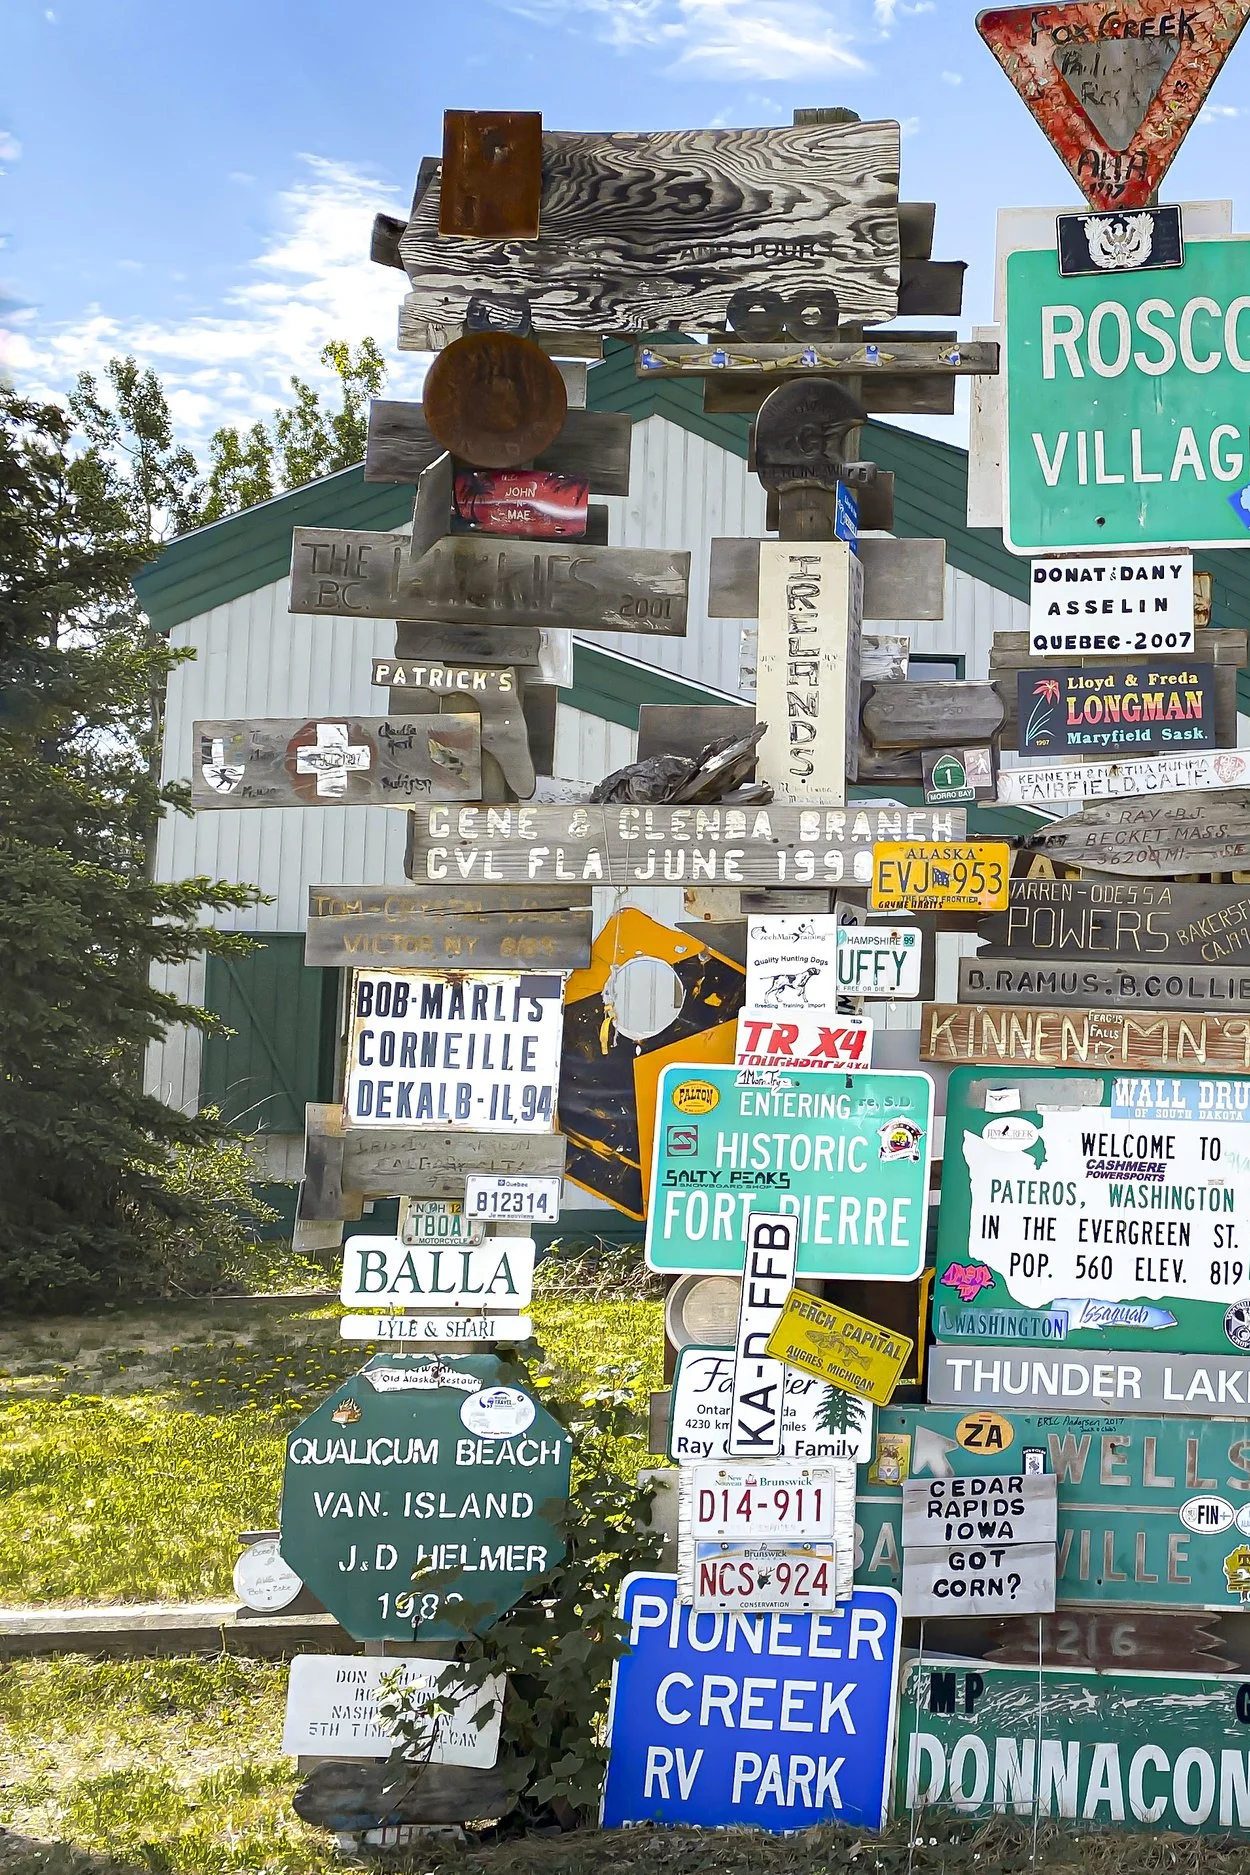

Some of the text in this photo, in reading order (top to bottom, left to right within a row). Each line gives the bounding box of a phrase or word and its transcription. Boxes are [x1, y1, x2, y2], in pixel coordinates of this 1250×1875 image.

[1048, 598, 1168, 616] ASSELIN
[376, 664, 513, 692] PATRICK'S
[1067, 672, 1199, 692] Lloyd & Freda
[1066, 691, 1203, 725] LONGMAN
[1067, 727, 1208, 746] Maryfield Sask.
[930, 789, 972, 800] MORRO BAY
[906, 848, 977, 861] ALASKA
[880, 861, 1003, 894] EVJ 953
[847, 936, 901, 946] HAMPSHIRE
[1008, 907, 1169, 952] POWERS
[754, 955, 829, 966] Quality Hunting Dogs
[1090, 1024, 1119, 1040] FALLS
[358, 1030, 539, 1072] CORNEILLE
[739, 1091, 851, 1120] ENTERING
[1113, 1080, 1188, 1109] WALL
[1134, 1109, 1244, 1121] OF SOUTH DAKOTA
[715, 1132, 868, 1174] HISTORIC
[1081, 1132, 1221, 1161] WELCOME TO
[662, 1170, 790, 1189] SALTY PEAKS
[1085, 1159, 1167, 1173] CASHMERE
[1085, 1171, 1165, 1182] POWERSPORTS
[476, 1191, 548, 1213] 812314
[991, 1179, 1234, 1213] PATEROS, WASHINGTON
[981, 1215, 1239, 1250] IN THE EVERGREEN ST.
[355, 1250, 520, 1295] BALLA
[1009, 1253, 1243, 1286] POP. 560 ELEV. 819
[377, 1320, 495, 1337] LYLE & SHARI
[789, 1299, 901, 1360] PERCH CAPITAL
[953, 1312, 1064, 1339] WASHINGTON
[946, 1359, 1142, 1398] THUNDER
[289, 1437, 561, 1466] QUALICUM BEACH
[677, 1437, 859, 1459] Ray Family
[760, 1477, 812, 1487] Brunswick
[930, 1477, 1024, 1499] CEDAR
[313, 1491, 534, 1519] VAN. ISLAND
[699, 1488, 822, 1523] D14-911
[928, 1499, 1025, 1518] RAPIDS
[945, 1522, 1014, 1541] IOWA
[948, 1550, 1006, 1571] GOT
[700, 1563, 828, 1597] NCS 924
[933, 1575, 1022, 1600] CORN?
[656, 1672, 858, 1735] CREEK
[644, 1746, 846, 1810] RV PARK
